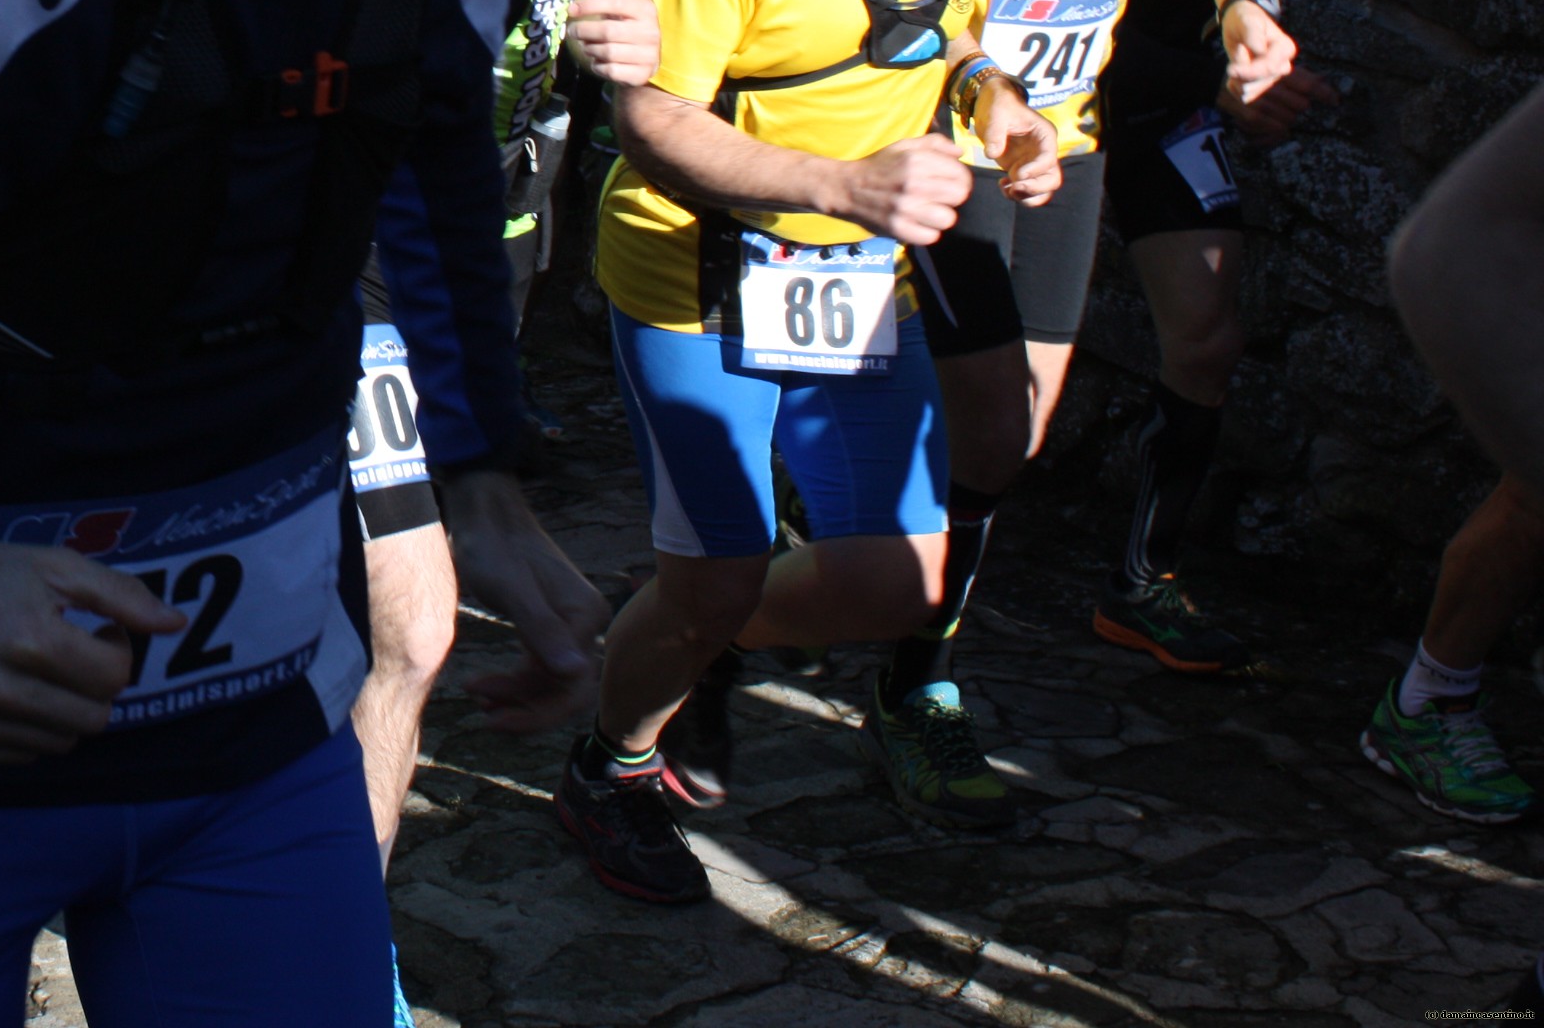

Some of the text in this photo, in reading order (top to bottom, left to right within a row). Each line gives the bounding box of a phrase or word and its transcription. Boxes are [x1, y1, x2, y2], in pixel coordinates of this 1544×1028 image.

[1016, 26, 1100, 90] 241
[784, 276, 855, 349] 86
[107, 646, 314, 724] encinisport.it
